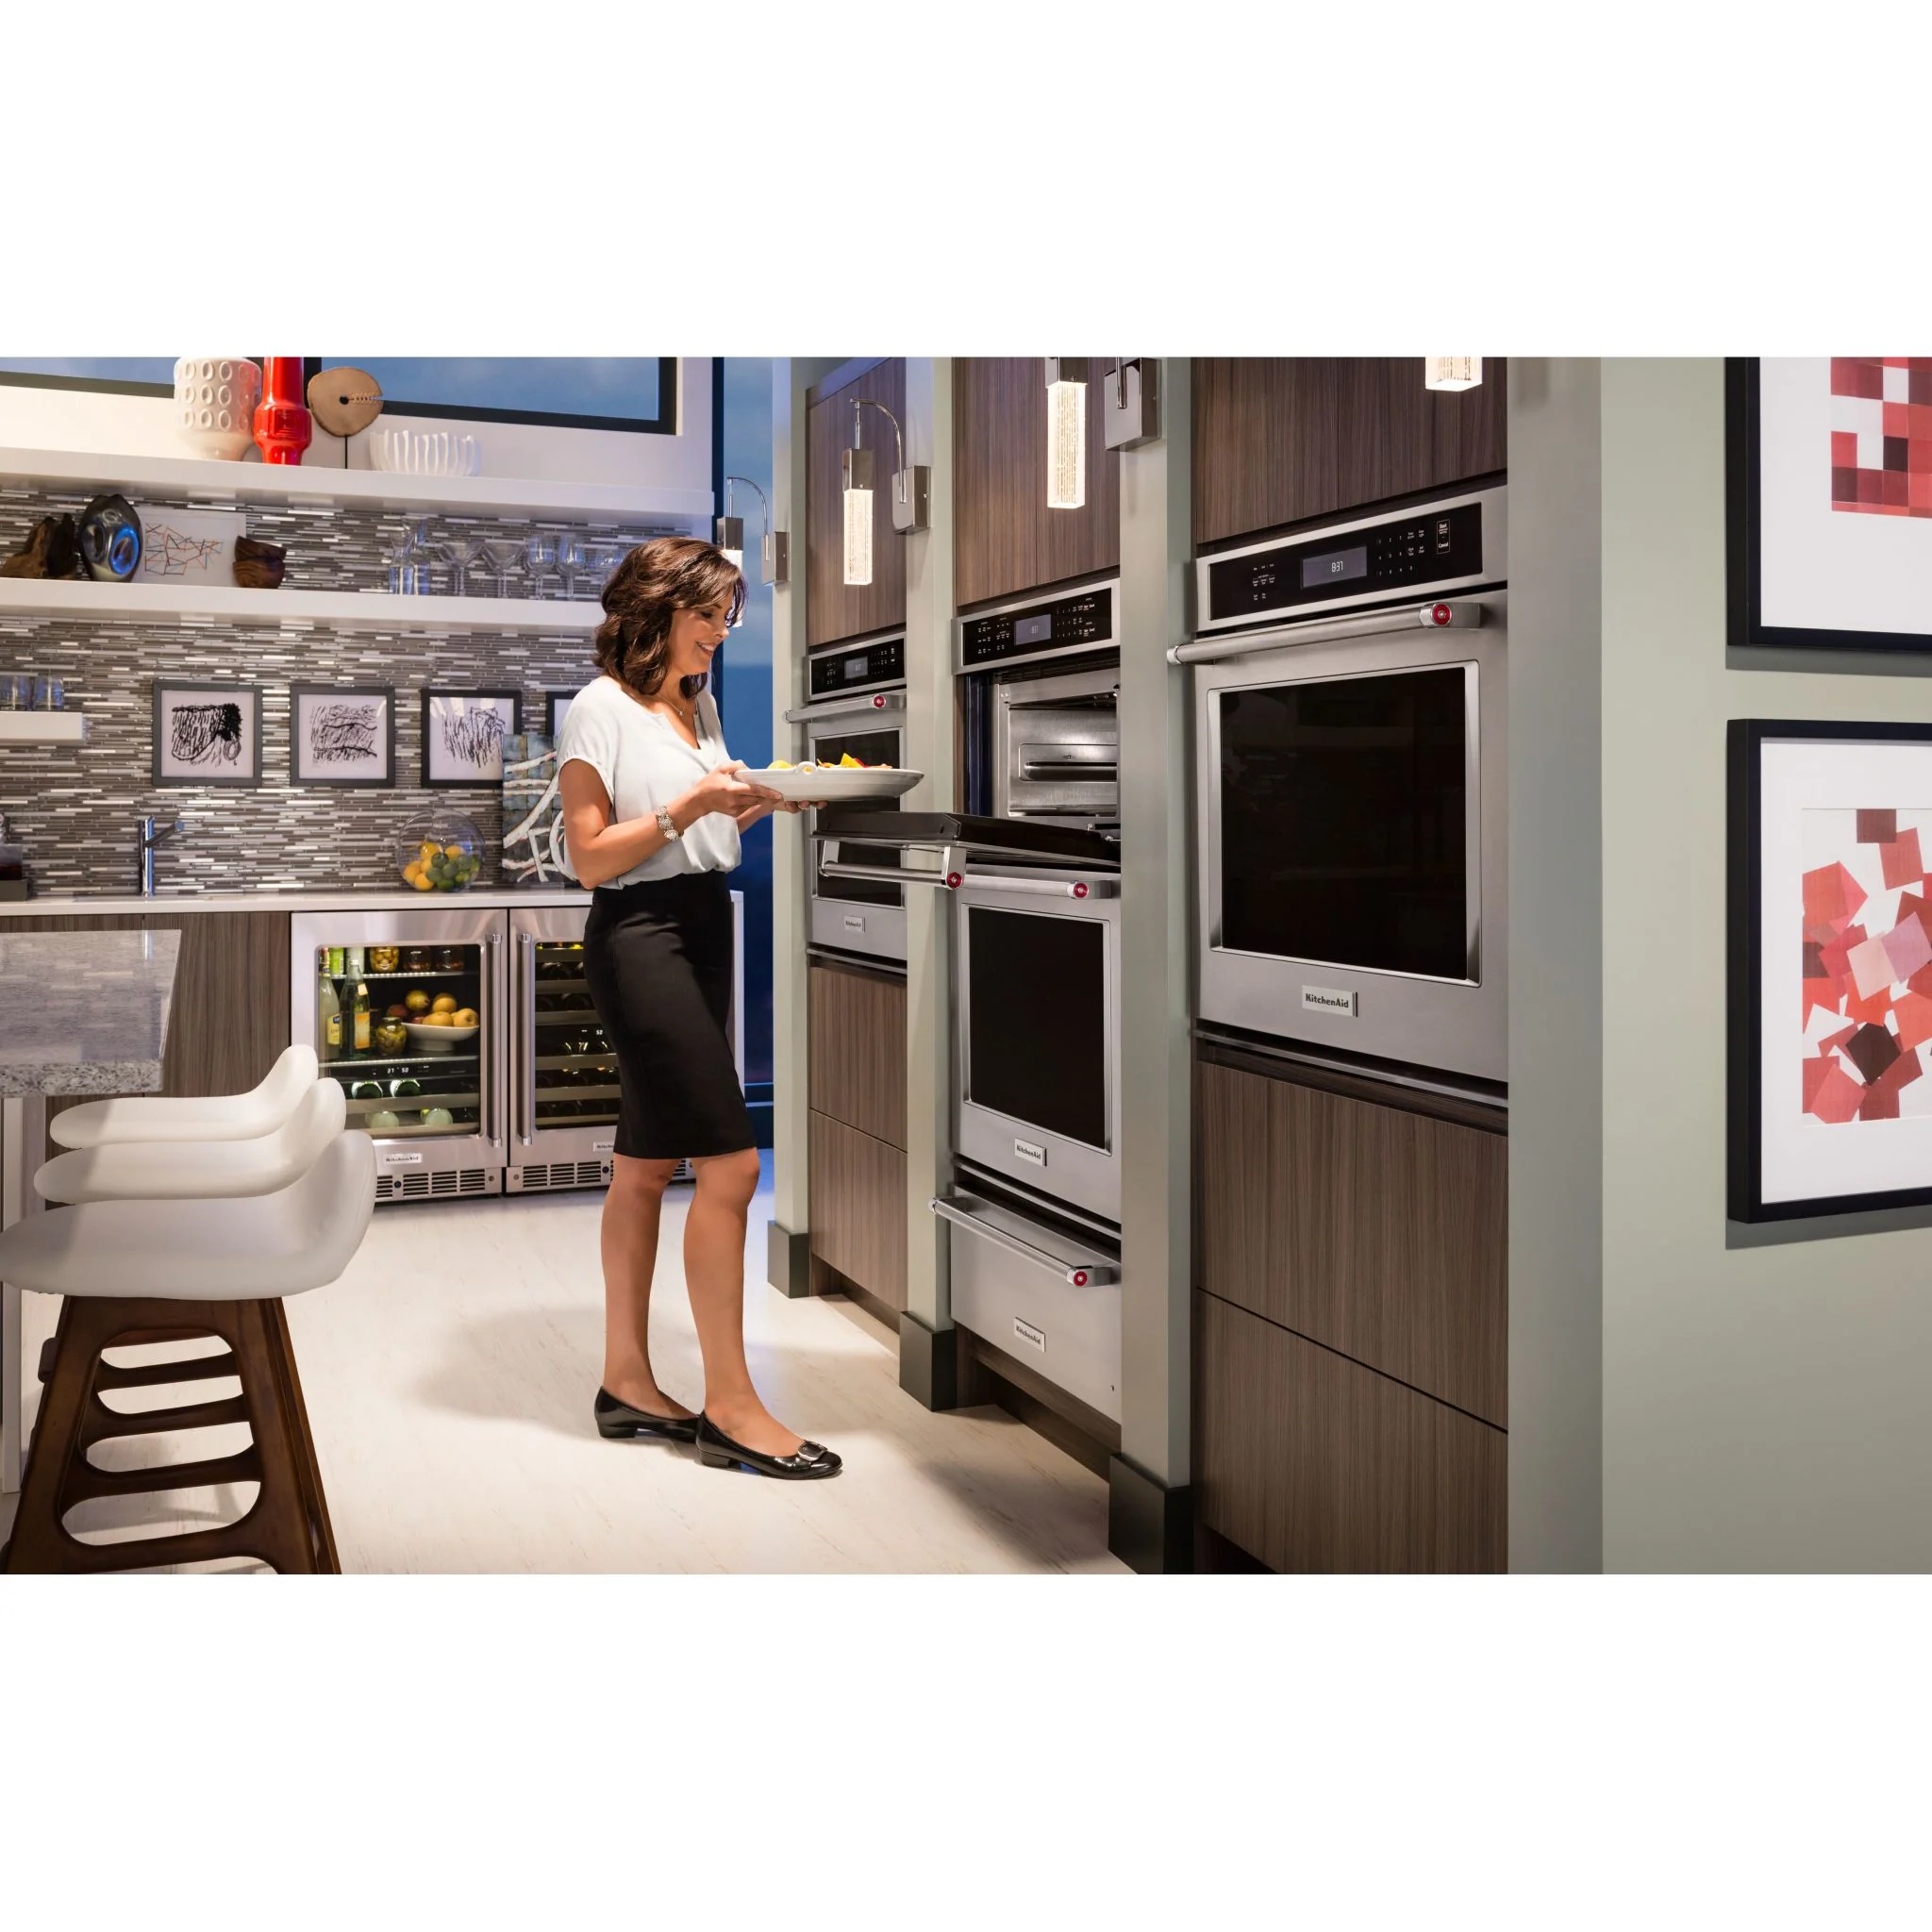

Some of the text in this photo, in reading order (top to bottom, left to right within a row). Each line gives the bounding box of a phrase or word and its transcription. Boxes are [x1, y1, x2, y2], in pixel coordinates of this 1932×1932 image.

[1305, 992, 1349, 1008] KitchenAid
[1016, 1143, 1041, 1160] KitchenAid
[1016, 1324, 1041, 1345] KitchenAid
